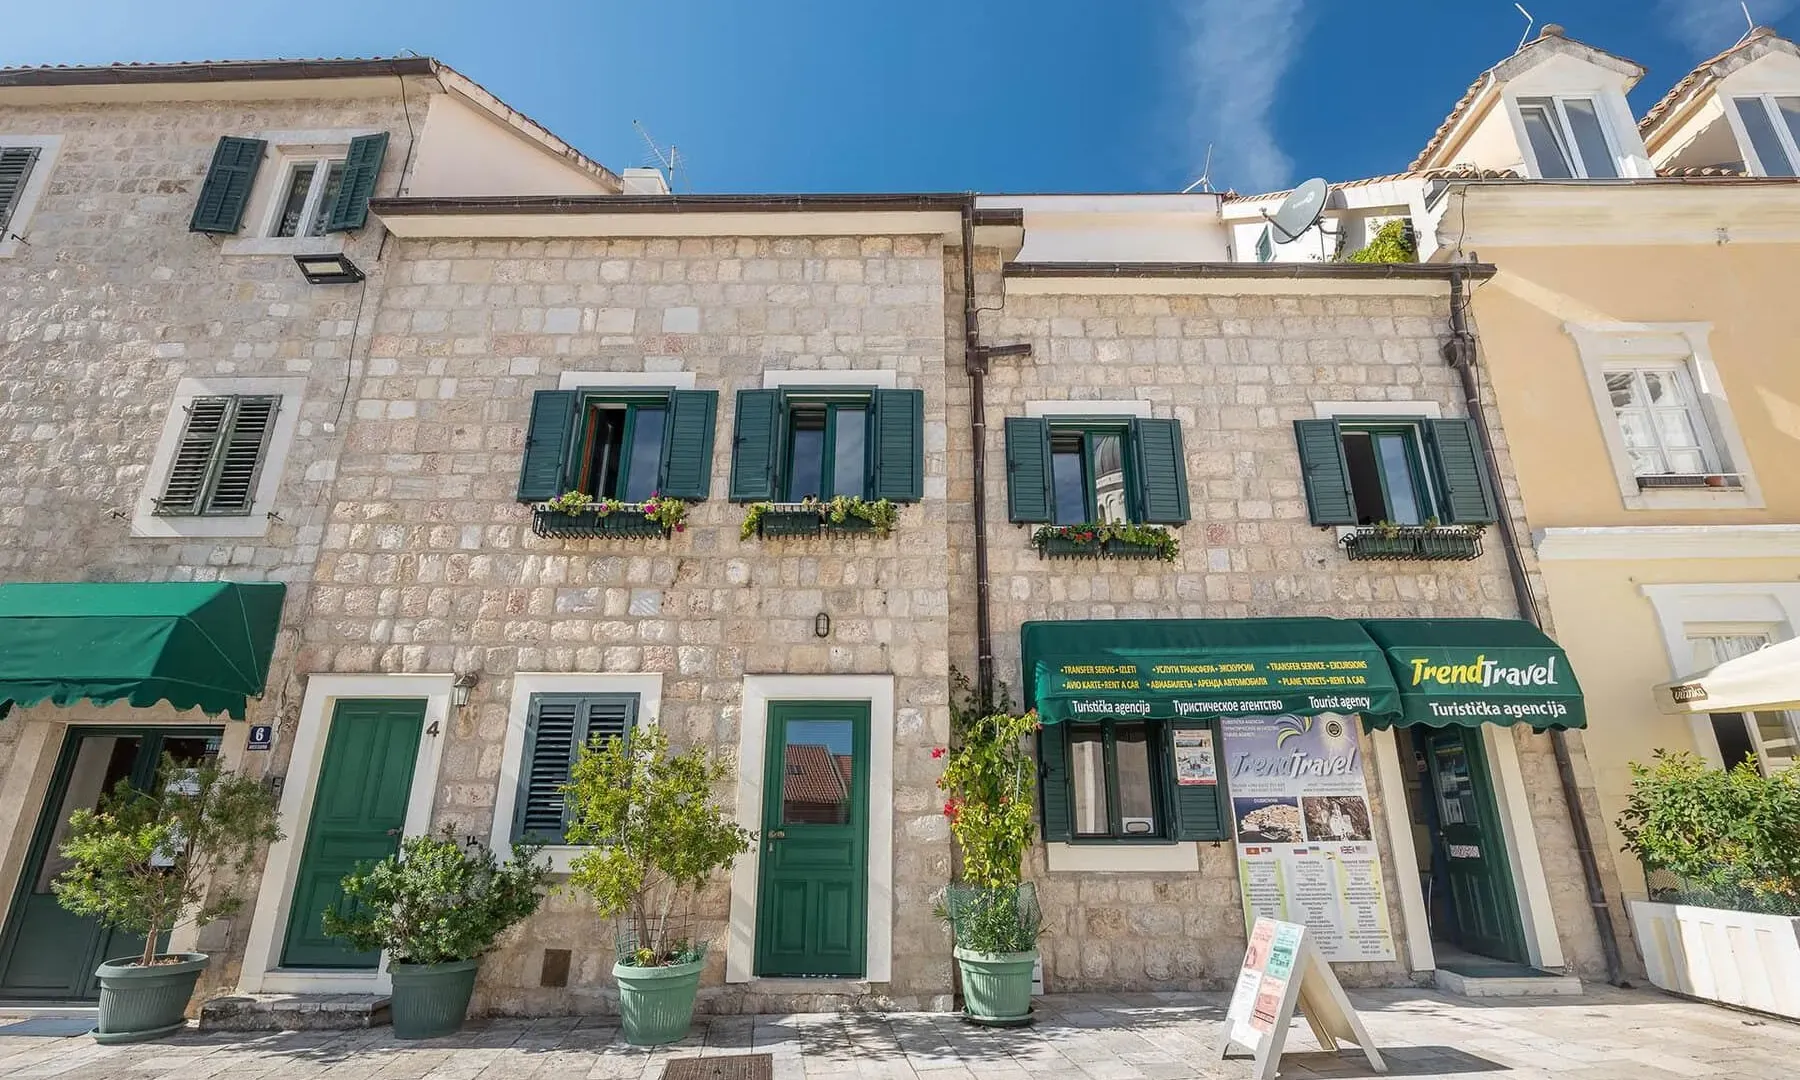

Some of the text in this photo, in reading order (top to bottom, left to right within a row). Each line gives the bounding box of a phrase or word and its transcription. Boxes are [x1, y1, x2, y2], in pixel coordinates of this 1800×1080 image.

[1063, 665, 1137, 674] TRANSFER SERVIS IZLETI
[1155, 663, 1255, 674] УСЛУГИ ТРАНСФЕРА ЭКСКУРСИИ
[1269, 660, 1368, 671] TRANSFER SERVICE EXCURSIONS
[1066, 681, 1081, 690] AVIO
[1082, 681, 1101, 689] KARTE
[1104, 681, 1120, 689] RENT
[1127, 680, 1140, 689] CAR
[1151, 677, 1268, 689] АВИАБИЛЕТЫ АРЕНДА АВТОМОБИЛЯ
[1282, 677, 1303, 686] PLANE
[1303, 676, 1327, 685] TICKETS
[1329, 676, 1346, 685] RENT
[1353, 675, 1366, 684] CAR
[1072, 699, 1151, 716] Turistička agencija
[1172, 700, 1283, 716] Туристическое агентство
[1308, 695, 1370, 710] Tourist agency
[1429, 701, 1567, 718] Turistička agencija
[255, 727, 265, 742] 6
[426, 720, 440, 737] 4
